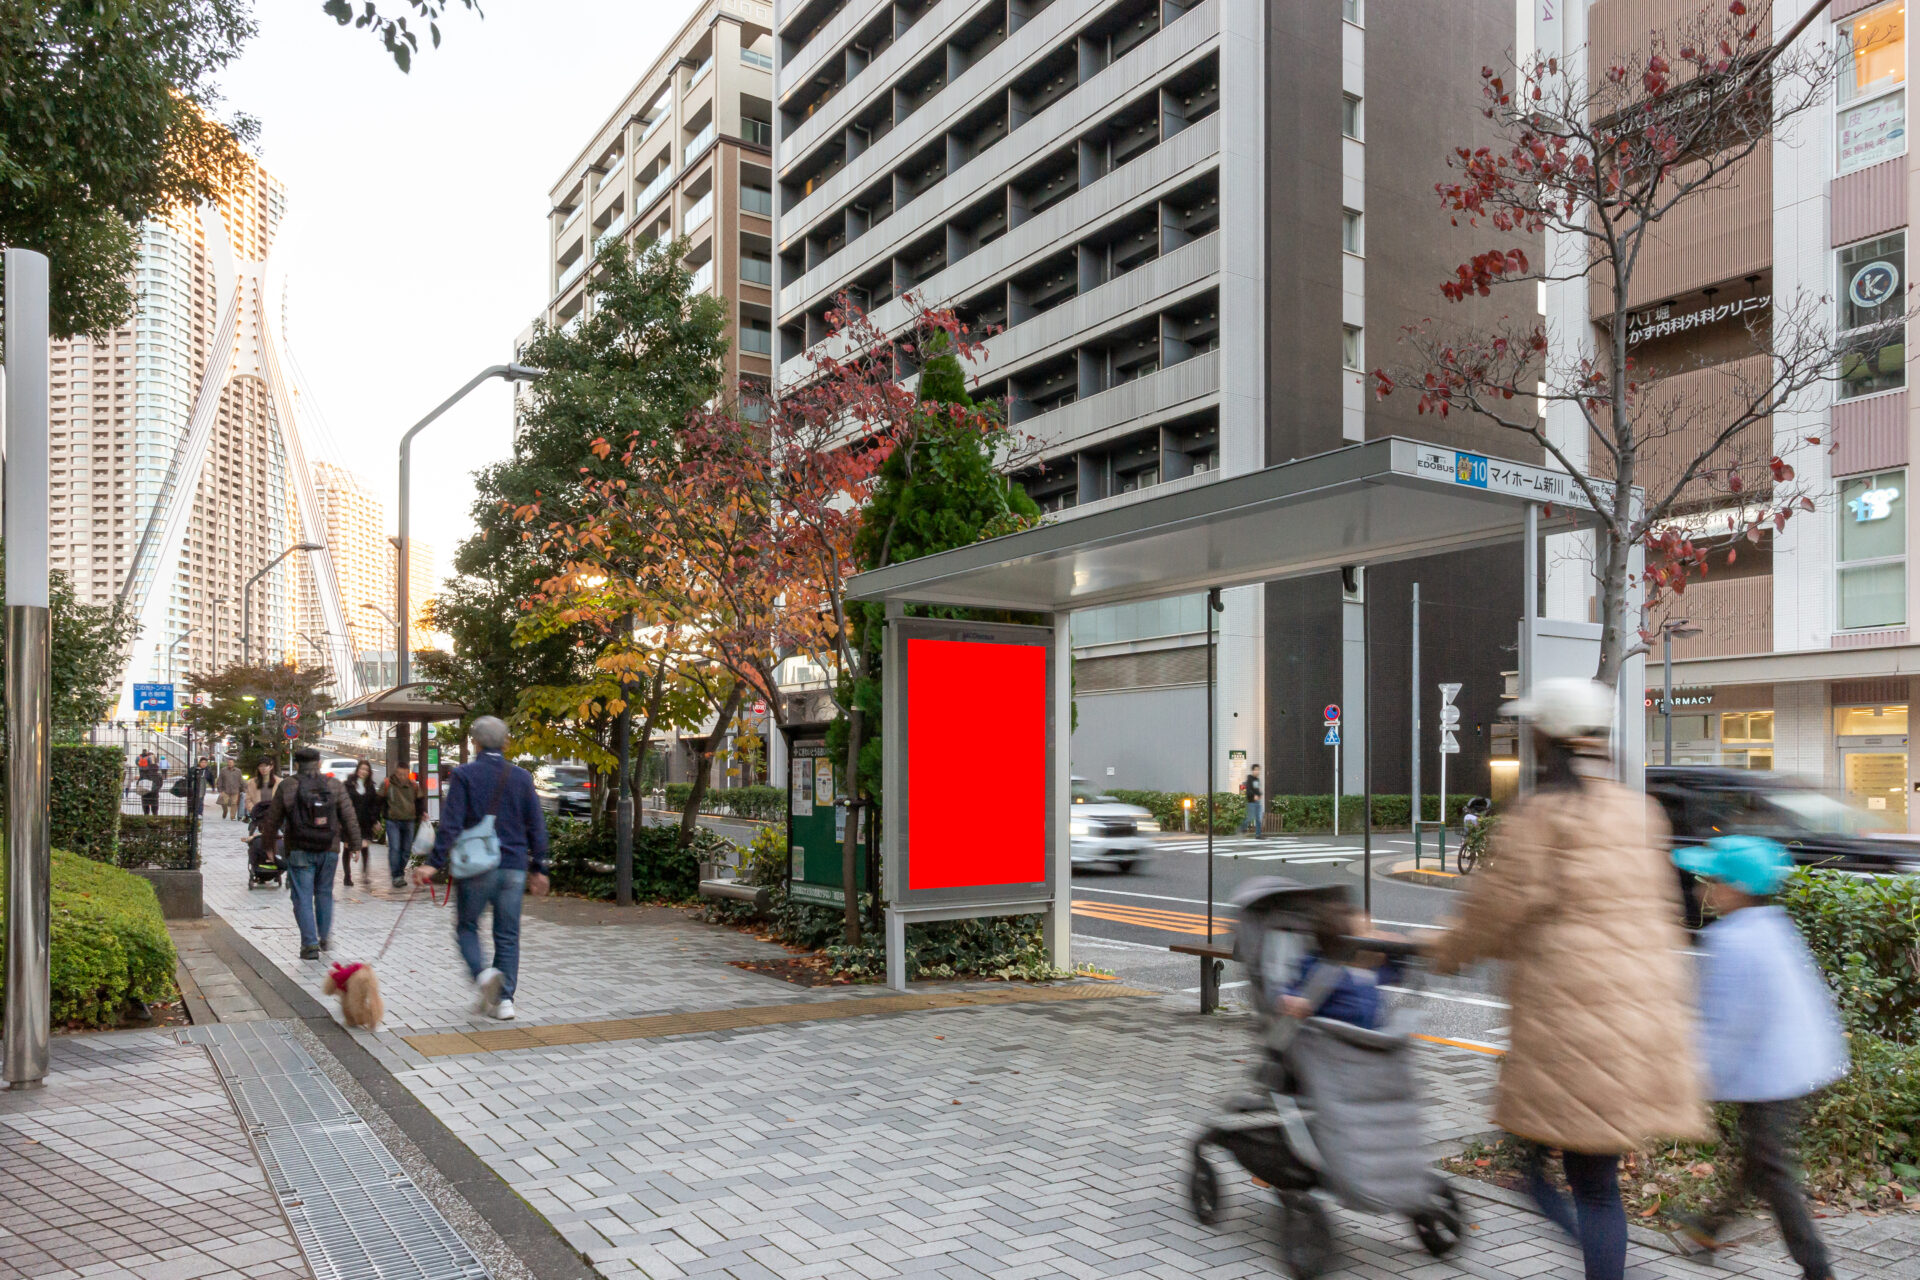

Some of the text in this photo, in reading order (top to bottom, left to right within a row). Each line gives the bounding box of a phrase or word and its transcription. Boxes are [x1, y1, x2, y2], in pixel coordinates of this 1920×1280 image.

[1628, 305, 1671, 329] 八丁堀
[1417, 459, 1455, 473] EDOBUS
[1472, 461, 1487, 482] 10
[1489, 467, 1564, 496] マイホーム新川
[1655, 696, 1713, 706] PARMACY
